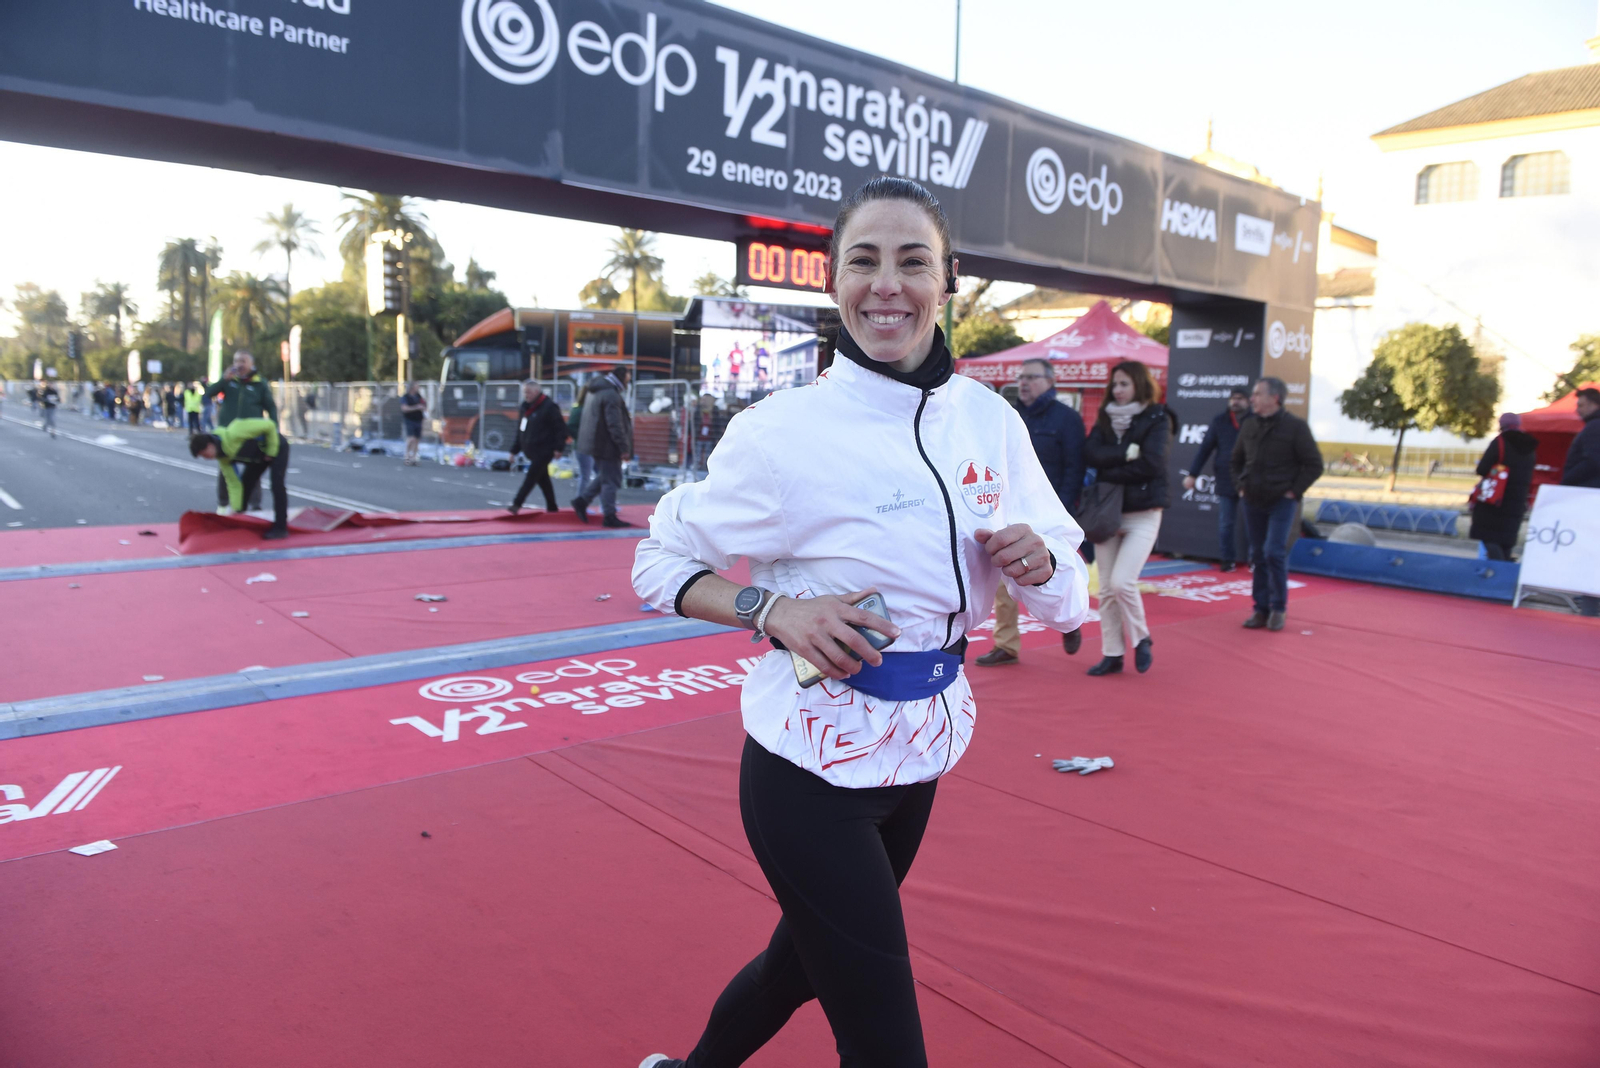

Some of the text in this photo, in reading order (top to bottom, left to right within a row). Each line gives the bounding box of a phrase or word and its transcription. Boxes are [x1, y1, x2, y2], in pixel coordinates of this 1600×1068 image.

[269, 16, 350, 54] Partner
[567, 11, 697, 113] edp
[774, 63, 952, 147] maratón
[686, 146, 843, 202] 29 enero 2023
[822, 122, 953, 188] sevilla
[1067, 164, 1123, 226] edp
[1160, 197, 1217, 242] HOKA
[1285, 325, 1312, 361] edp
[1198, 375, 1249, 386] HYUNDAI
[876, 498, 926, 514] TEAMERGY
[963, 481, 1001, 498] abades
[1524, 520, 1576, 553] edp
[472, 664, 732, 713] maratón
[515, 659, 637, 684] edp
[570, 672, 750, 715] sevilla
